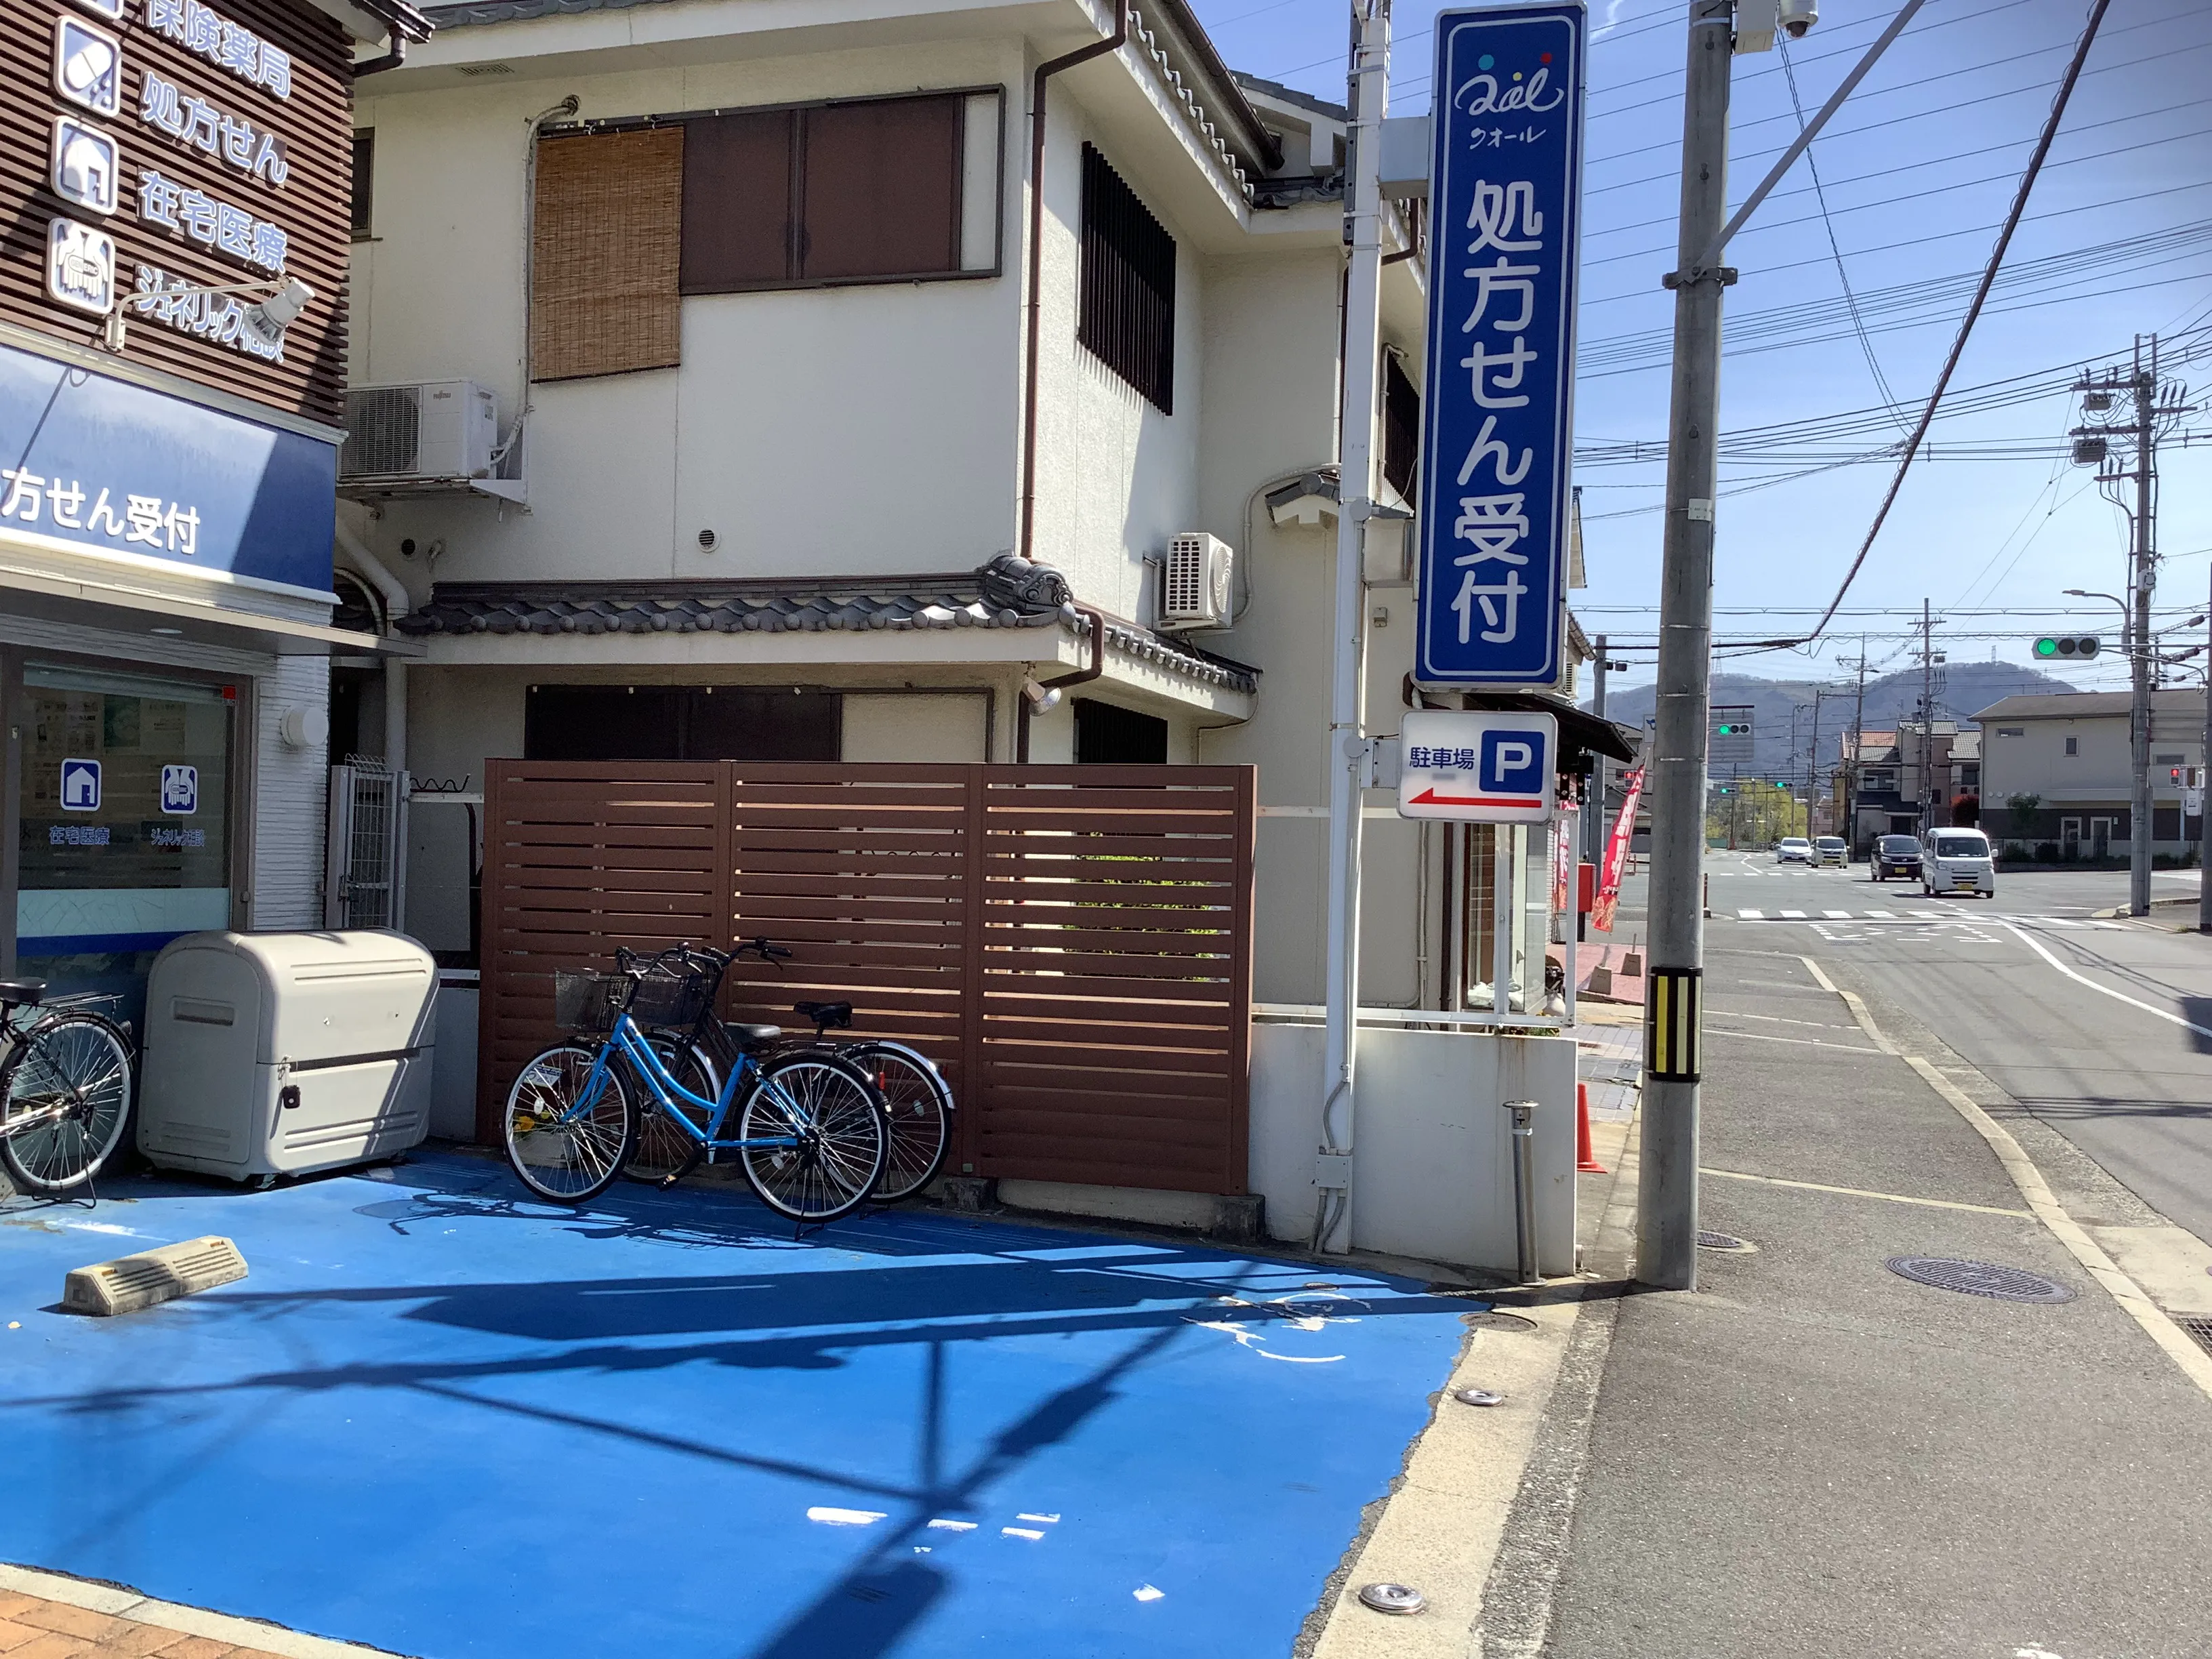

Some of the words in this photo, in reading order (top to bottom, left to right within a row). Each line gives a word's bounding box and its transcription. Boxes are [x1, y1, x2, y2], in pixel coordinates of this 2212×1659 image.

[143, 70, 289, 184] 処方せん
[1469, 125, 1547, 150] クオール
[139, 170, 288, 274] 在宅医療
[1450, 179, 1543, 644] 処方せん受付
[0, 466, 201, 554] 方せん受付
[1409, 746, 1475, 771] 駐車場
[1494, 741, 1532, 782] P
[49, 825, 110, 846] 在宅医療
